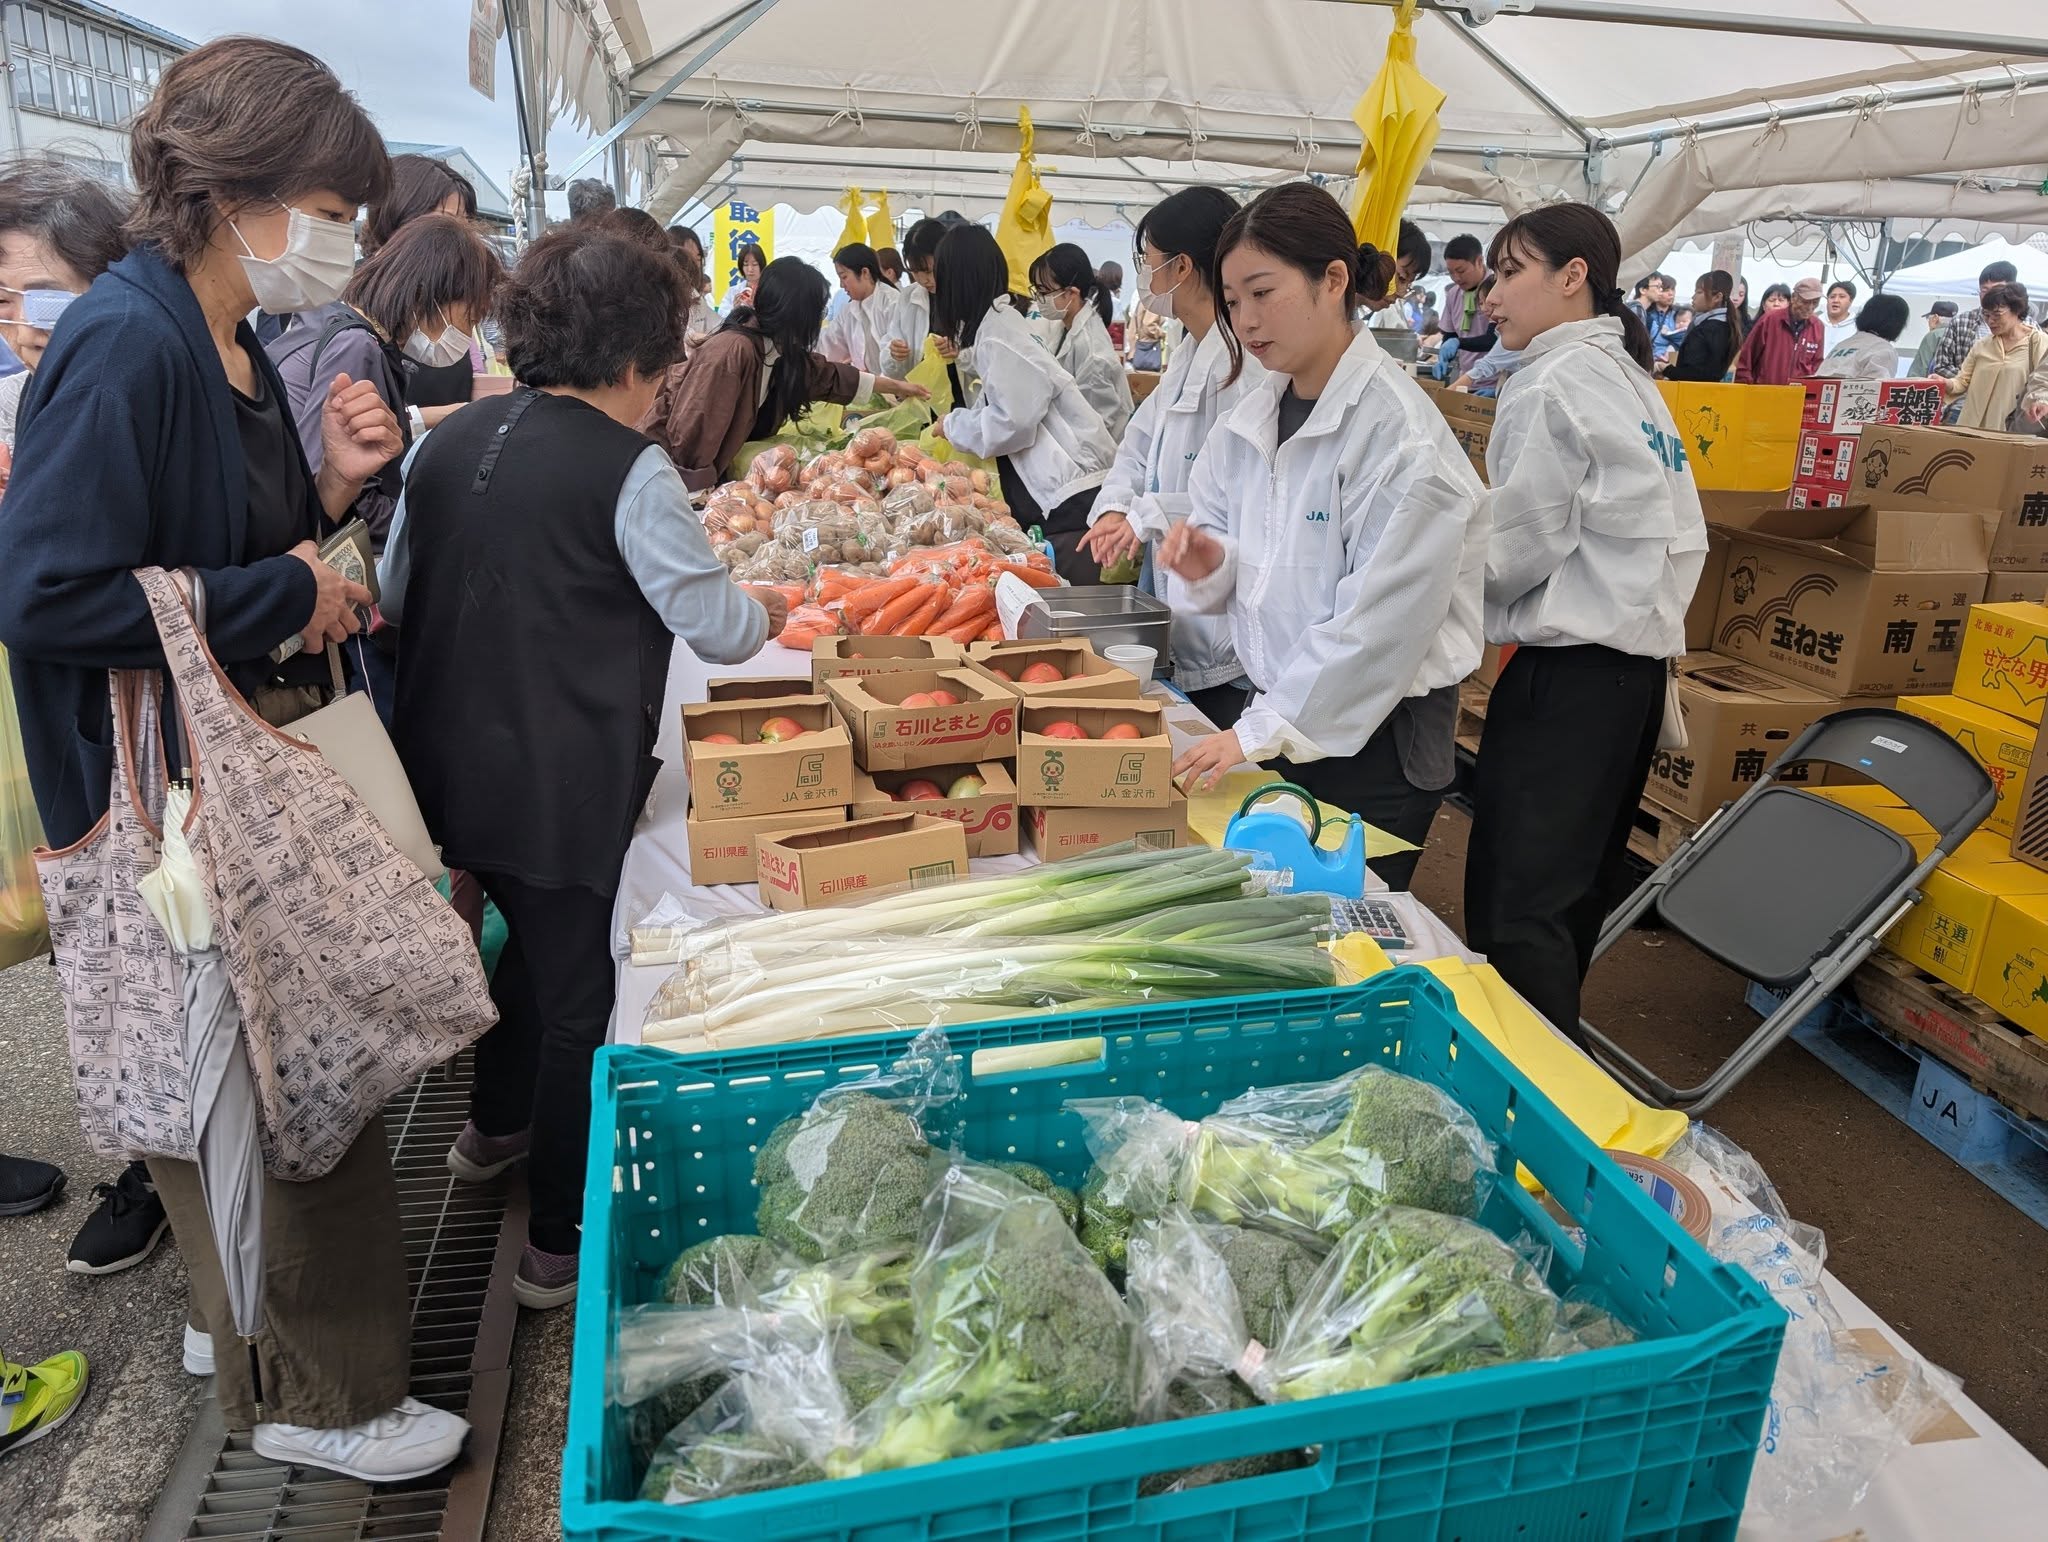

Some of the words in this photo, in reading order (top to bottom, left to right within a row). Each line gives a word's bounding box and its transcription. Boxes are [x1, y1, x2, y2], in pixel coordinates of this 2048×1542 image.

[2030, 464, 2047, 479] 共
[2018, 491, 2048, 526] 南
[1893, 593, 1910, 607] 共
[1883, 619, 1918, 653] 南
[1931, 619, 1961, 652] 玉
[1973, 618, 2016, 640] 北海道産
[1770, 616, 1844, 664] 玉ねぎ
[895, 713, 980, 735] 石川とまと
[1740, 723, 1757, 735] 共
[1732, 748, 1767, 782] 南
[781, 792, 799, 802] JA
[803, 787, 838, 800] 金沢市
[1100, 788, 1117, 798] JA
[1121, 788, 1156, 799] 金沢市
[1058, 833, 1100, 846] 石川県産
[703, 845, 749, 859] 石川県産
[760, 849, 787, 876] 石川とまと
[819, 874, 868, 895] 石川県産
[1922, 1088, 1958, 1127] JA
